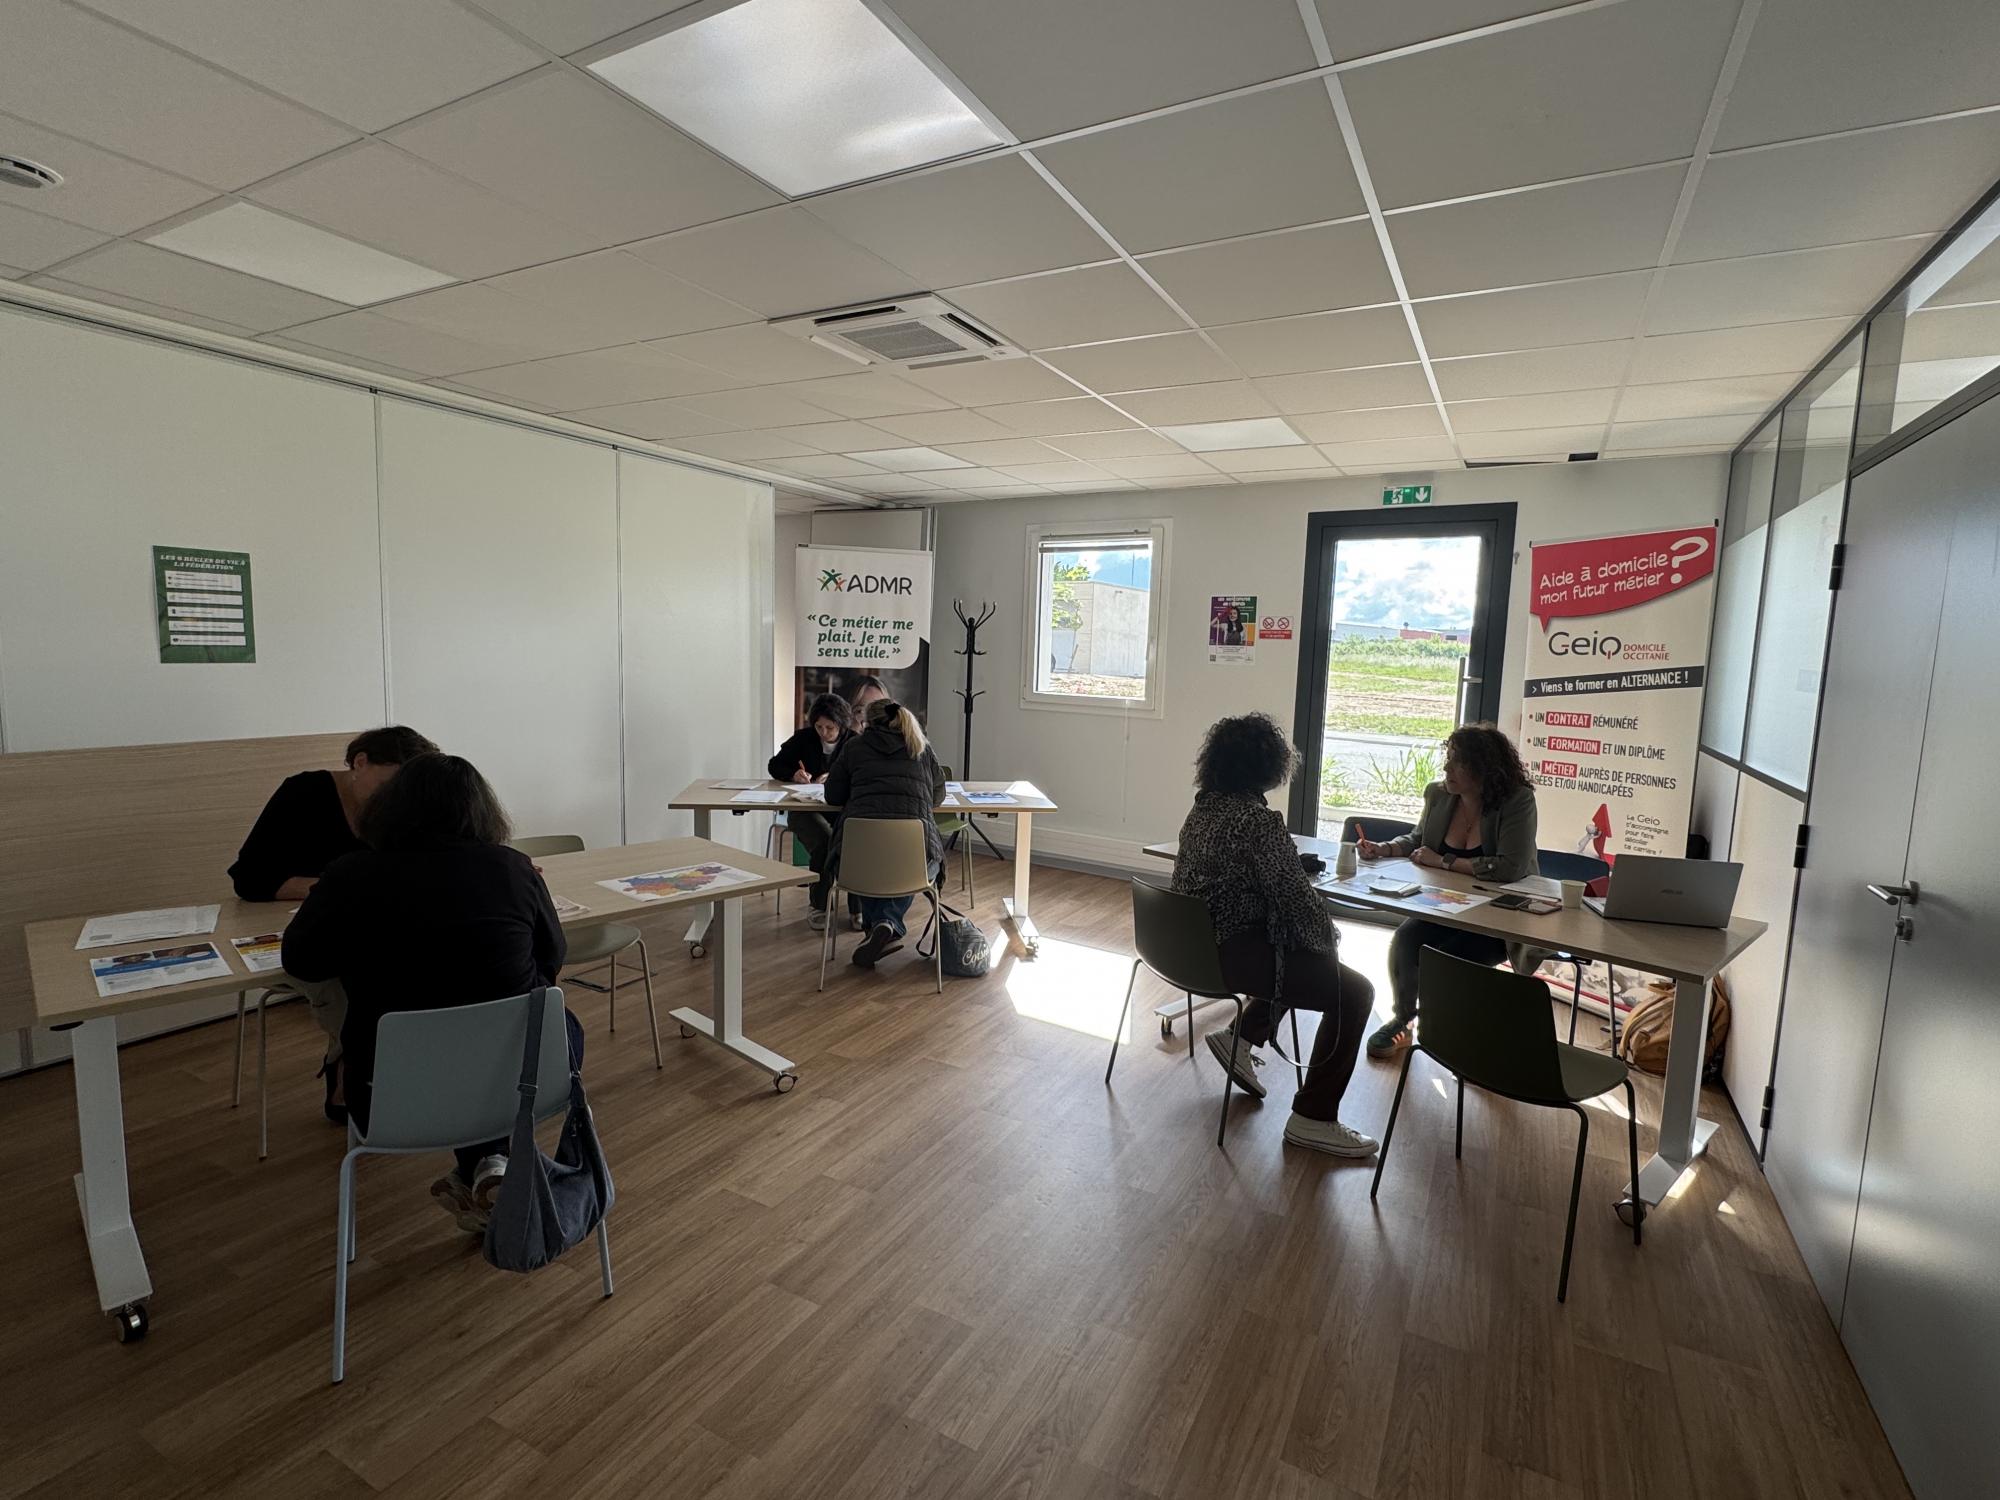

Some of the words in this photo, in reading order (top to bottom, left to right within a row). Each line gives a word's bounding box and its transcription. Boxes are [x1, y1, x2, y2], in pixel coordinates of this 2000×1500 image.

[1540, 571, 1575, 589] Aide
[1580, 567, 1591, 581] à
[1597, 552, 1669, 577] domicile
[847, 574, 912, 595] ADMR
[1540, 590, 1568, 605] mon
[1573, 582, 1608, 600] futur
[1614, 572, 1664, 593] métier
[842, 616, 888, 629] métier
[893, 620, 914, 630] me
[817, 629, 856, 644] plait.
[860, 631, 874, 646] Je
[879, 634, 900, 644] me
[1624, 643, 1666, 652] DOMICILE
[817, 647, 850, 658] sens
[1623, 652, 1670, 660] OCCITANIE
[1541, 682, 1562, 693] Viens
[1564, 682, 1573, 691] te
[1575, 679, 1605, 691] former
[1607, 680, 1618, 688] en
[1621, 671, 1682, 688] ALTERNANCE
[1535, 712, 1544, 722] UN
[1547, 714, 1589, 727] CONTRAT
[1592, 714, 1639, 730] RÉMUNÉRÉ
[1533, 737, 1547, 748] UNE
[1551, 738, 1598, 753] FORMATION
[1602, 743, 1613, 754] ET
[1614, 744, 1627, 755] UN
[1628, 744, 1666, 760] DIPLÔME
[1530, 761, 1540, 772] UN
[1545, 762, 1575, 776] MÉTIER
[1579, 767, 1609, 781] AUPRÈS
[1611, 771, 1622, 783] DE
[1625, 772, 1677, 790] PERSONNES
[1555, 778, 1576, 790] ET/OU
[1577, 781, 1634, 798] HANDICAPÉES
